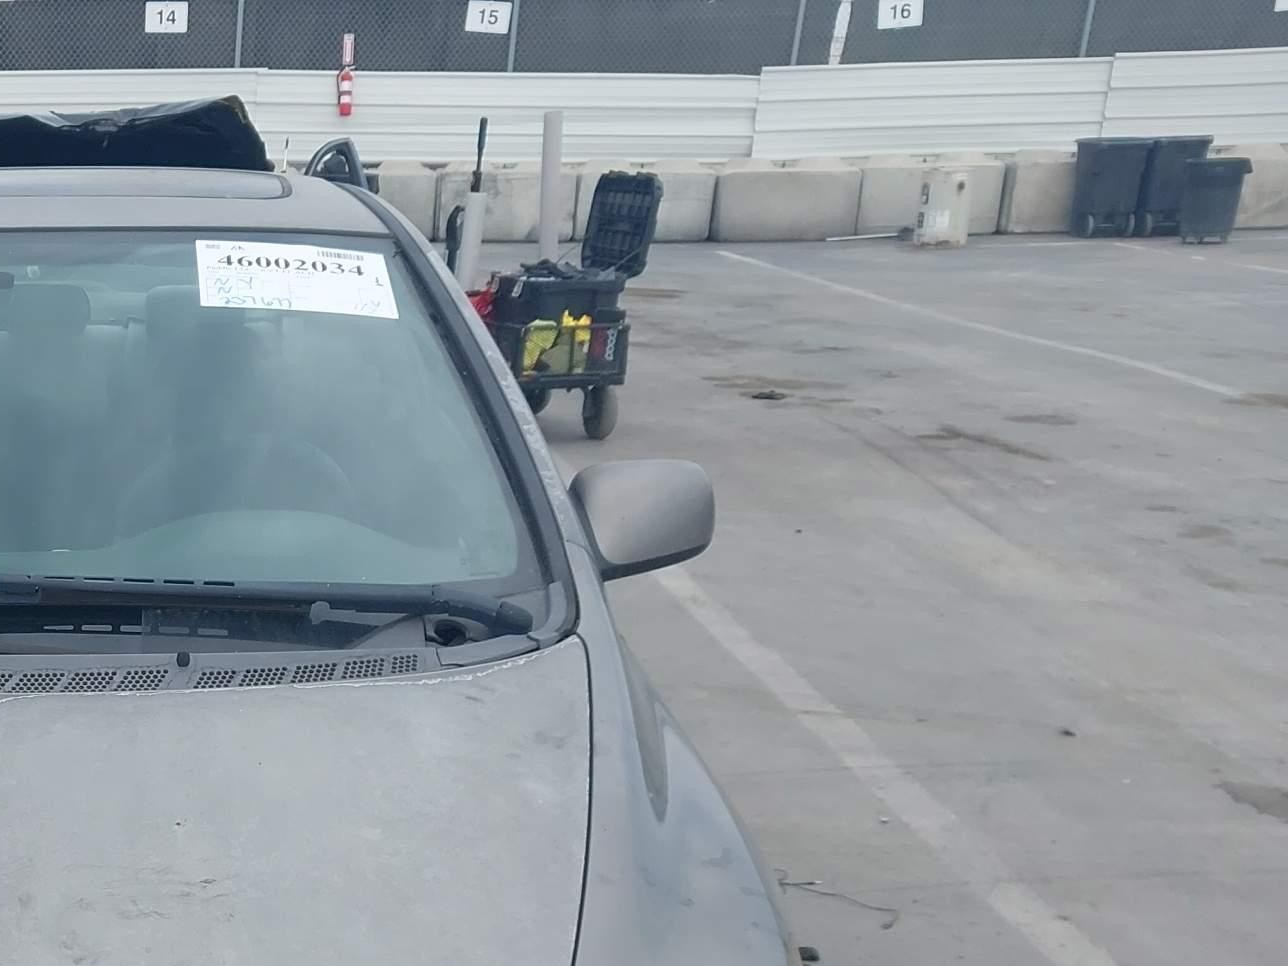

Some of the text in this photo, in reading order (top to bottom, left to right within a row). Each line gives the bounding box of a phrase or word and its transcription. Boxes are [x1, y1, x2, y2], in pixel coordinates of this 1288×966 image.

[157, 9, 177, 25] 14
[479, 8, 499, 25] 15
[890, 3, 911, 20] 16
[217, 254, 365, 277] 46002034
